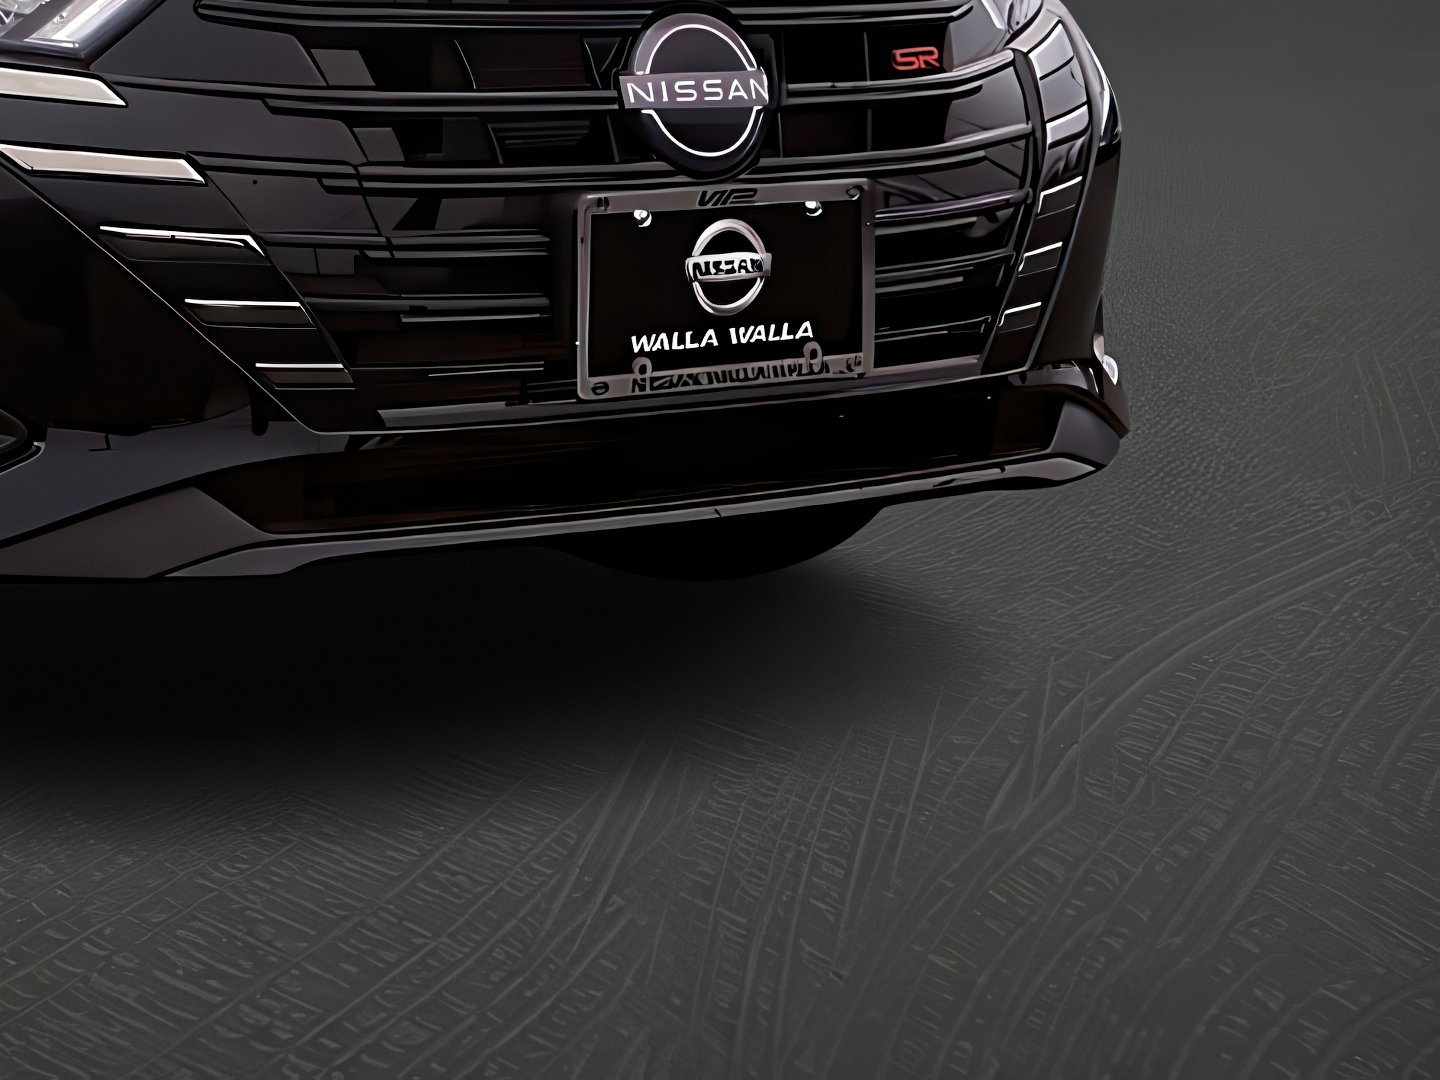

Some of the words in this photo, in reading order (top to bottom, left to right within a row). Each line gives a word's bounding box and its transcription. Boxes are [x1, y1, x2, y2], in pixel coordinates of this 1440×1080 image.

[891, 45, 940, 71] SR
[625, 77, 770, 104] NISSAN
[630, 328, 719, 354] WALLA
[728, 320, 814, 346] WALLA
